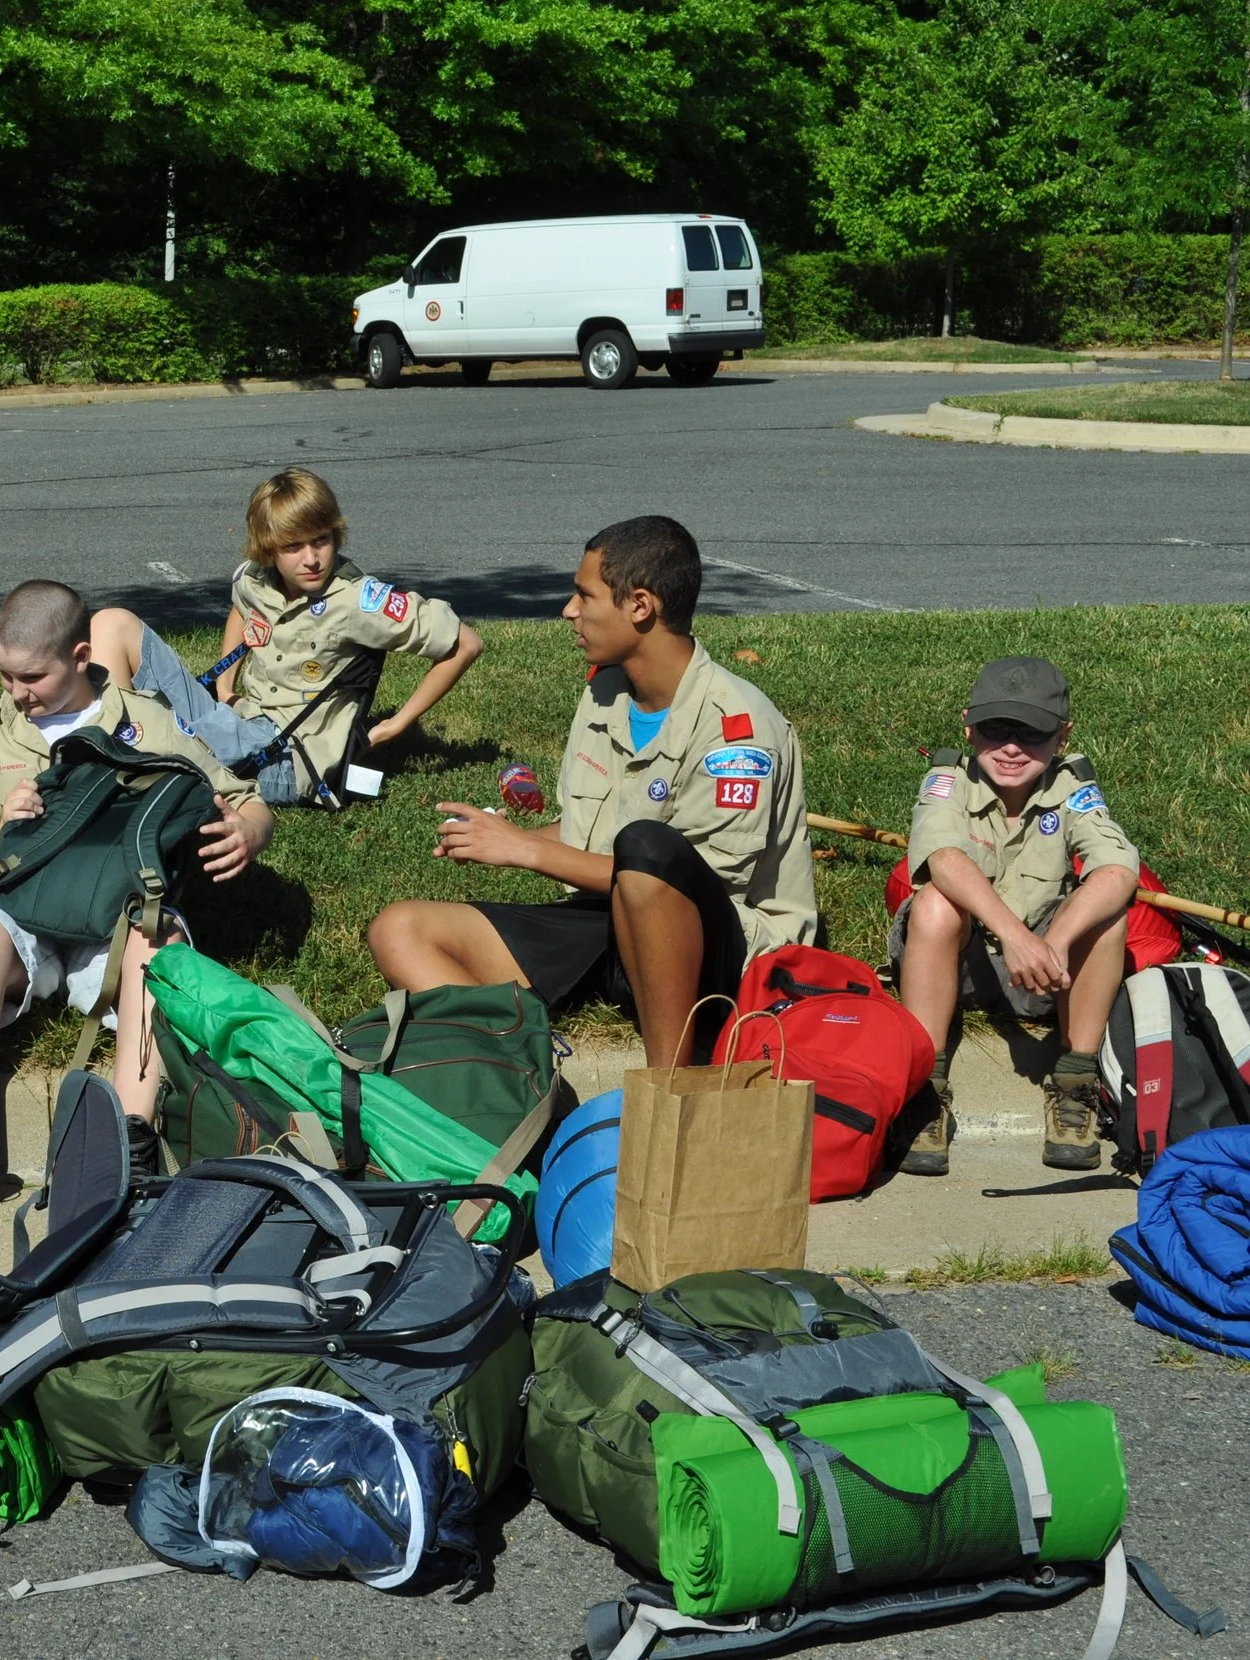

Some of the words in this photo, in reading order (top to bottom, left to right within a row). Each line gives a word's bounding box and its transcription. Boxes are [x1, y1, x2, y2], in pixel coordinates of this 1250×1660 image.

[214, 644, 246, 675] CRAZ
[721, 783, 754, 804] 128
[1144, 1081, 1159, 1095] 03
